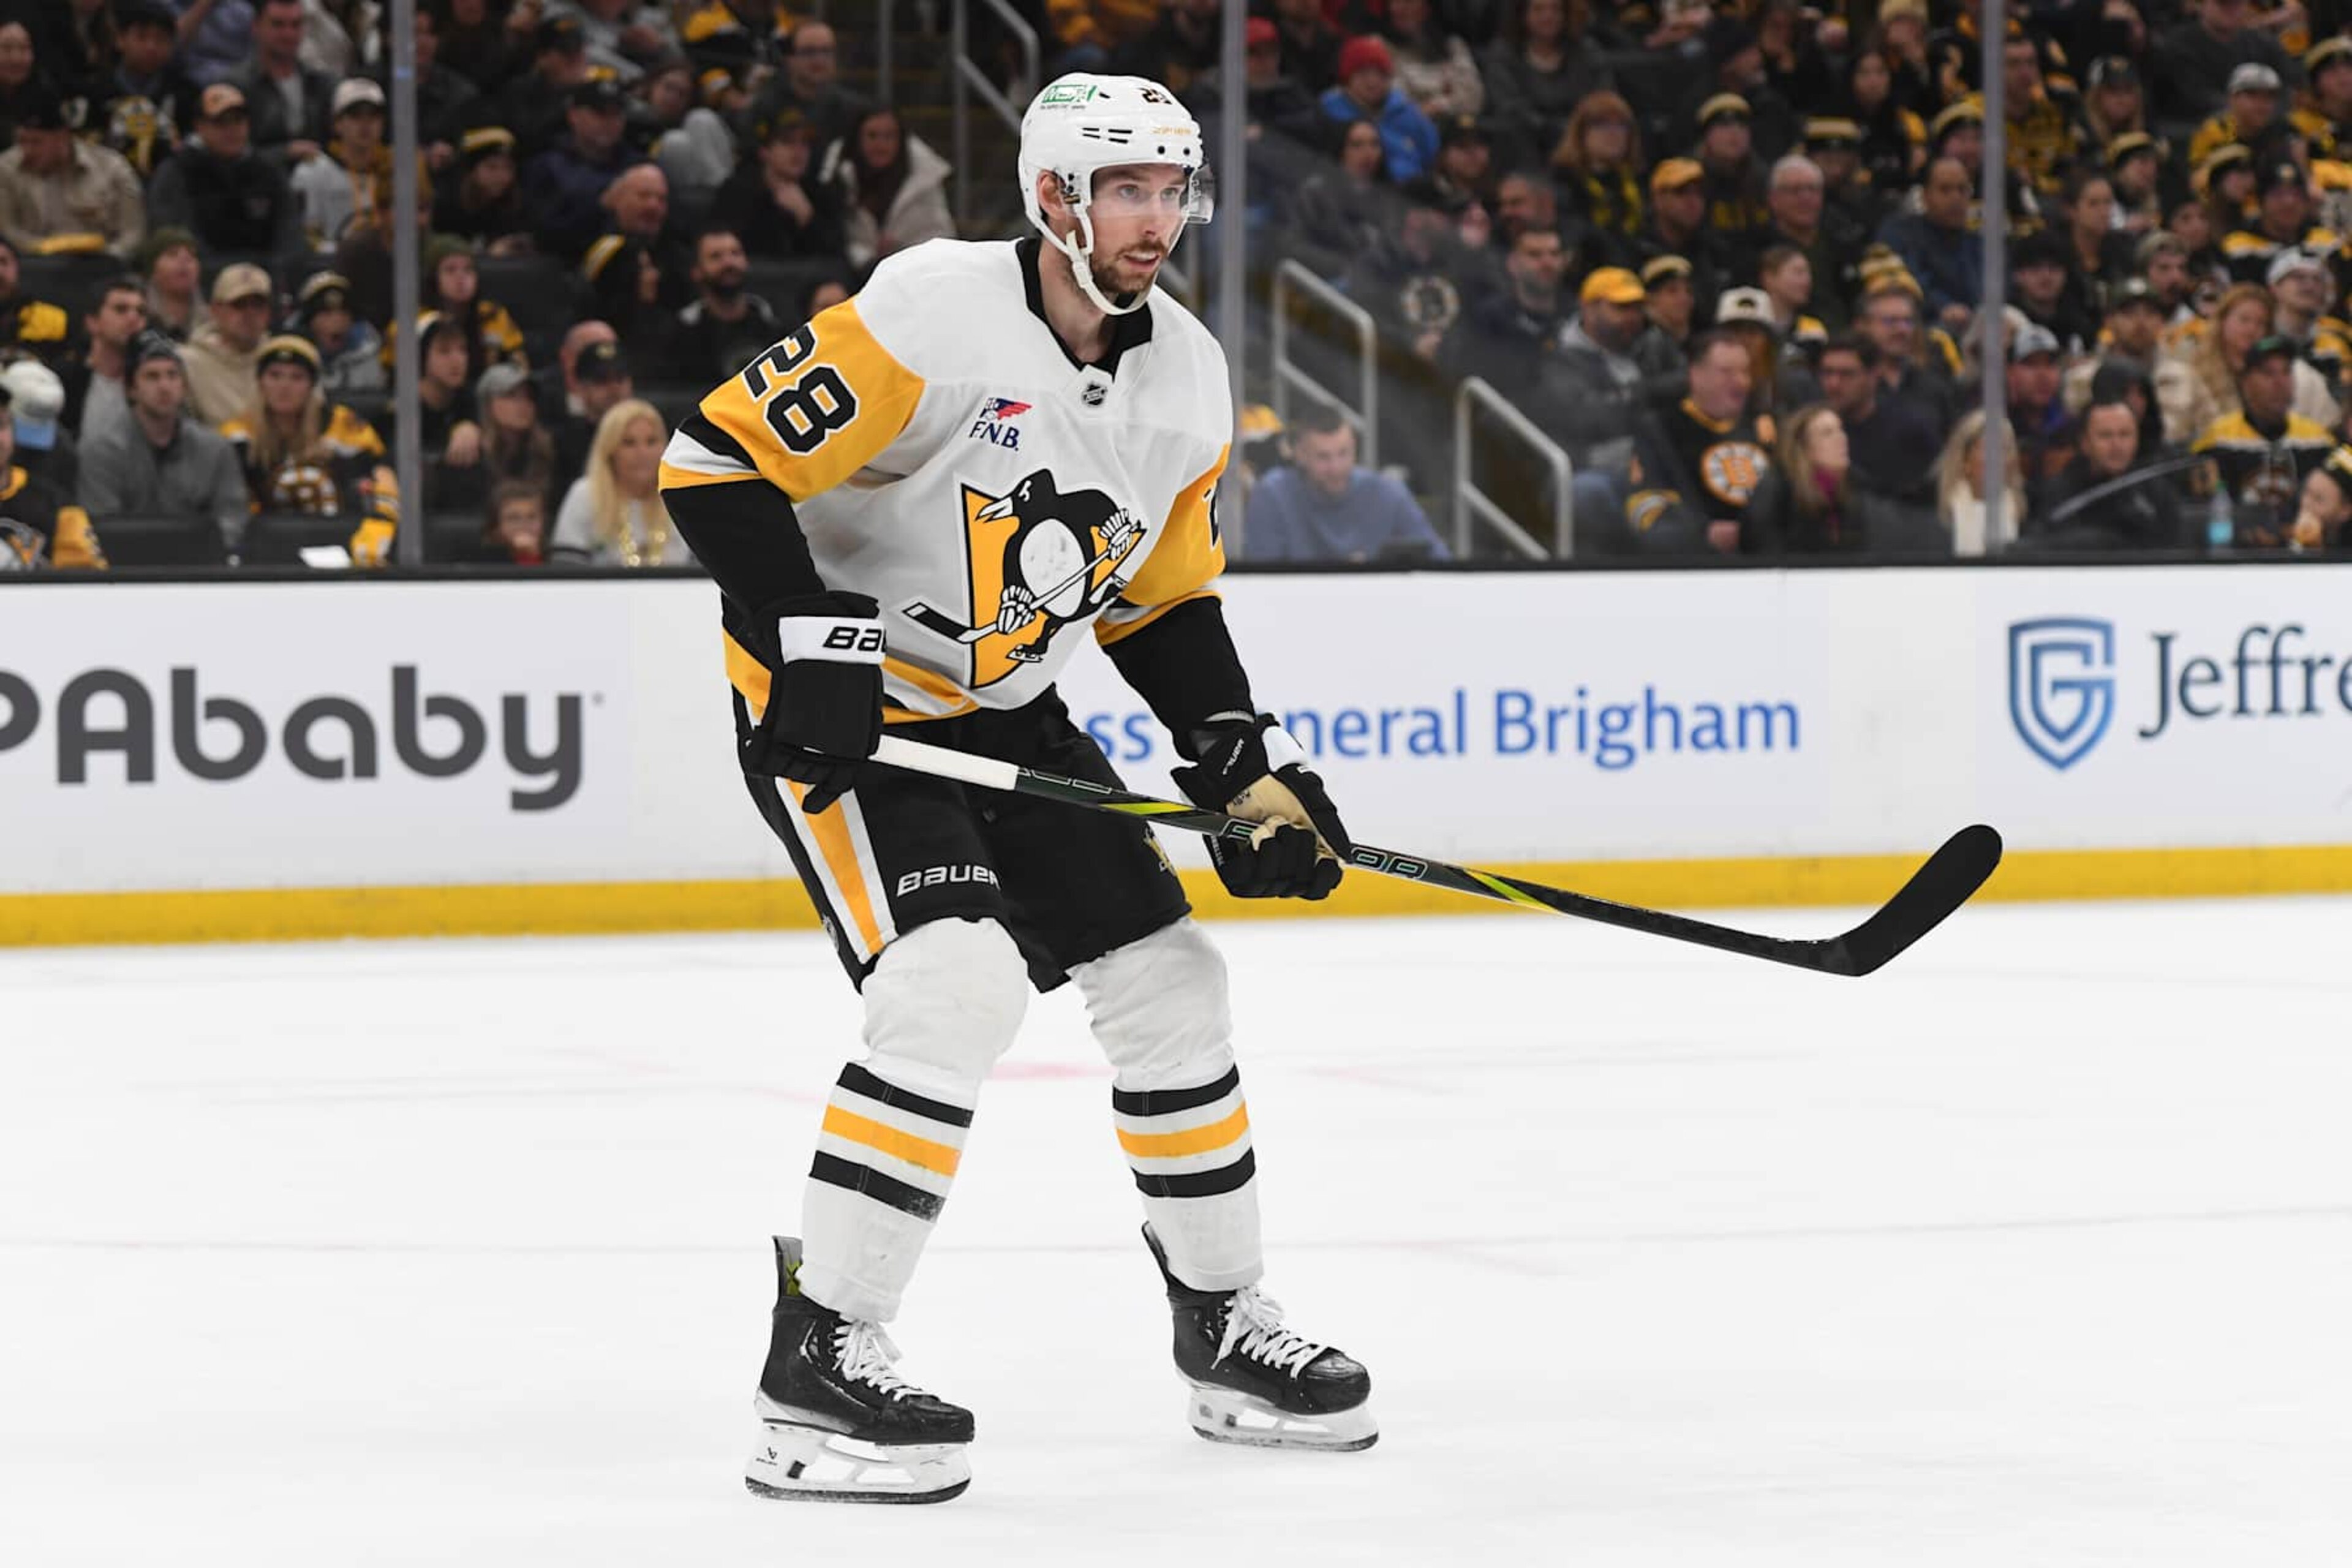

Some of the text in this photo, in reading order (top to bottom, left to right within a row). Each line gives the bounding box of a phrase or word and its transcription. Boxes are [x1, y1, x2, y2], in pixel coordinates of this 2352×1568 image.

[742, 322, 859, 456] 28
[823, 626, 887, 652] BA
[1085, 685, 1800, 771] ss neral Brigham
